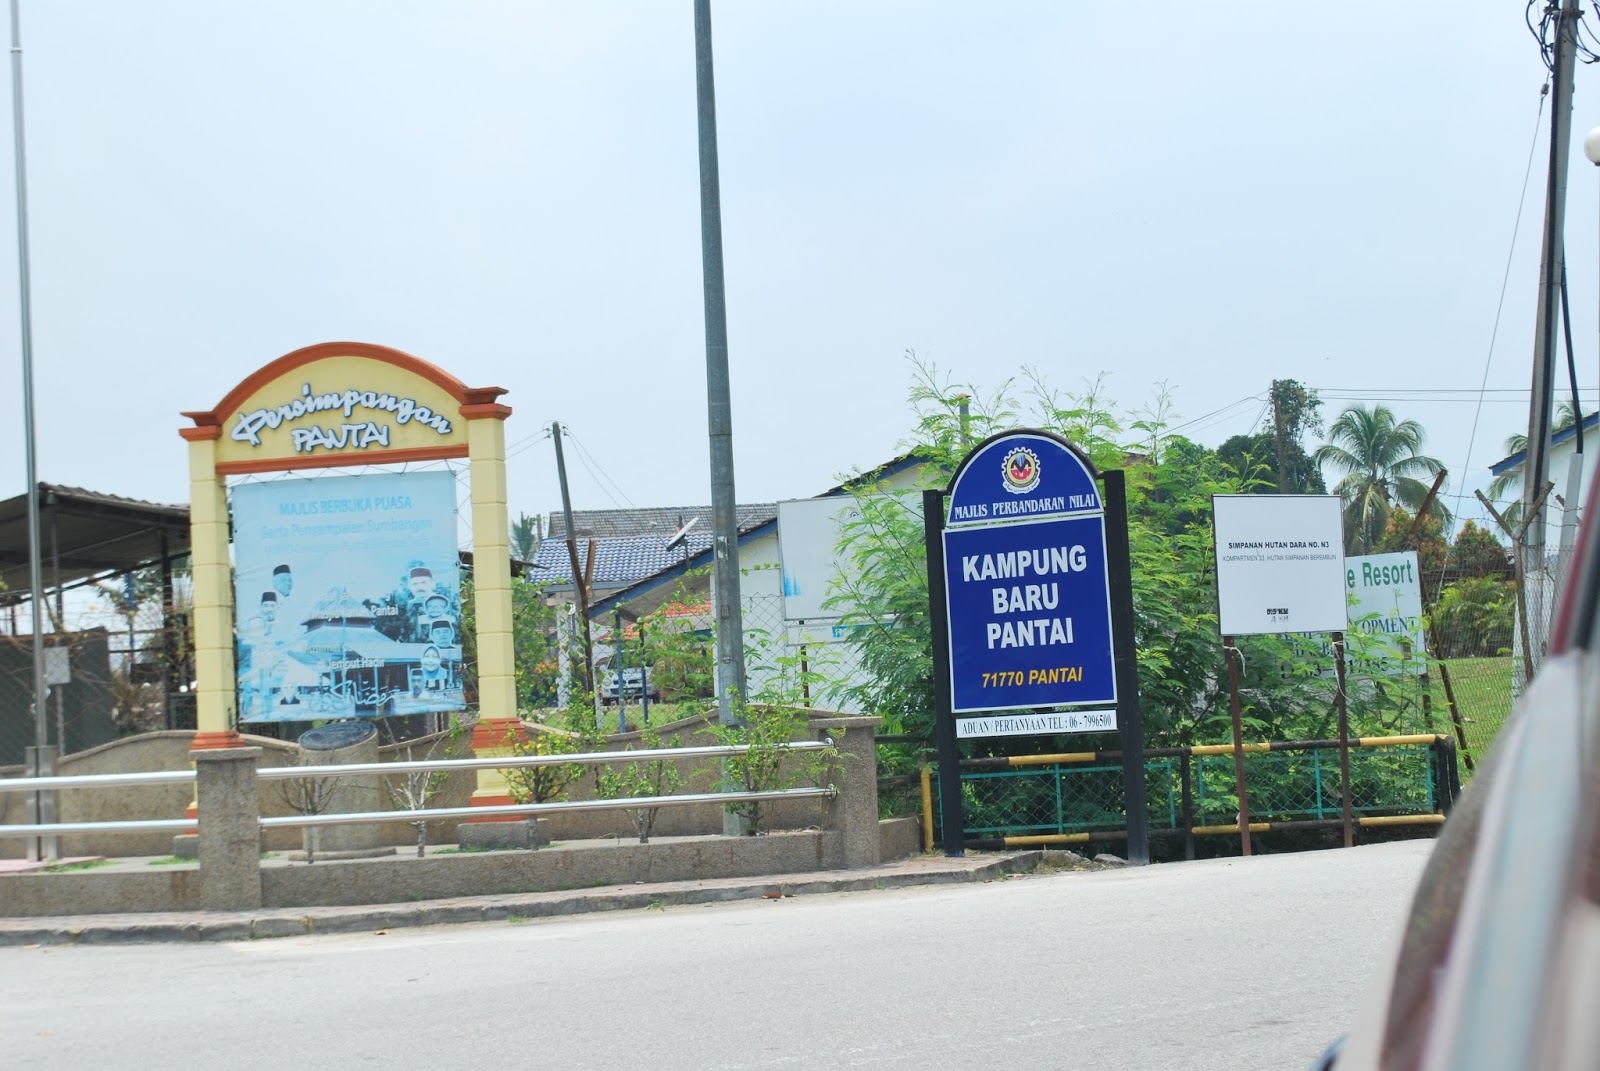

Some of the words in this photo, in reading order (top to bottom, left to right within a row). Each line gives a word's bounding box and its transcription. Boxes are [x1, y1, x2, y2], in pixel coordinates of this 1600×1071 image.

[230, 383, 453, 446] Persimpangan
[291, 421, 390, 452] PANTAI
[279, 502, 318, 516] MAJLIS
[321, 498, 372, 514] BERBUKA
[375, 495, 412, 510] PUASA
[954, 503, 988, 520] MAJLIS
[992, 496, 1065, 516] PERBANDARAN
[1069, 493, 1095, 509] NILAI
[962, 545, 1087, 582] KAMPUNG
[1222, 554, 1257, 562] KOMPARTMEN
[1362, 559, 1413, 587] Resort
[371, 604, 399, 616] Pantai
[992, 582, 1059, 614] BARU
[986, 617, 1074, 650] PANTAI
[1362, 616, 1416, 635] OPMENT
[981, 670, 1024, 688] 71770
[1027, 666, 1083, 686] PANTAI
[962, 722, 990, 735] ADUAN
[995, 717, 1046, 732] PERTANYAAN
[1084, 714, 1112, 728] 7996500
